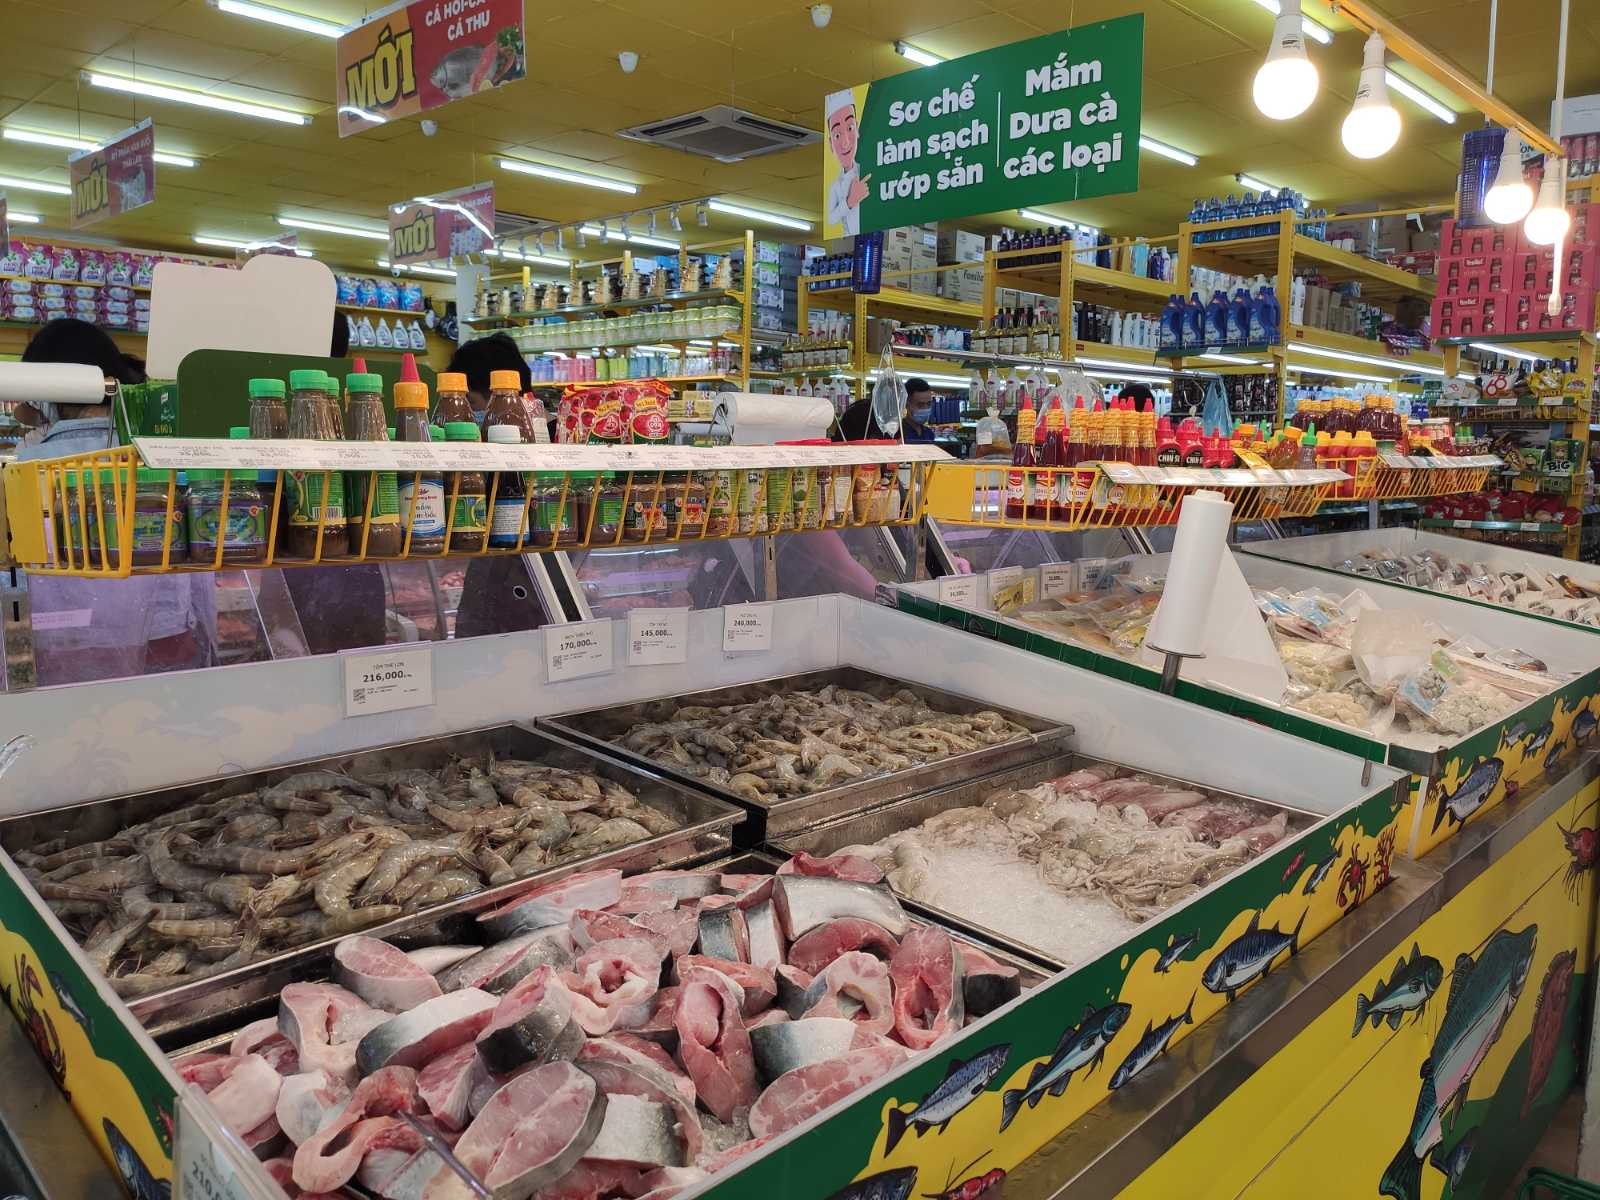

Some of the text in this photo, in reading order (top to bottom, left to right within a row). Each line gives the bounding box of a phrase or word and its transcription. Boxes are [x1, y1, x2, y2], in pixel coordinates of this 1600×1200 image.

[425, 3, 441, 27] CÁ
[448, 9, 491, 41] CÁ THU
[346, 22, 416, 114] MỚI
[1025, 51, 1102, 97] Mắm
[888, 73, 981, 127] Sơ chế
[1009, 91, 1118, 140] Dưa cà
[876, 118, 989, 166] làm sạch
[1003, 131, 1122, 179] các loại
[880, 155, 984, 201] ướp sẵn
[394, 209, 436, 259] MỚI
[560, 639, 591, 650] 170,000
[363, 670, 404, 683] 216,000
